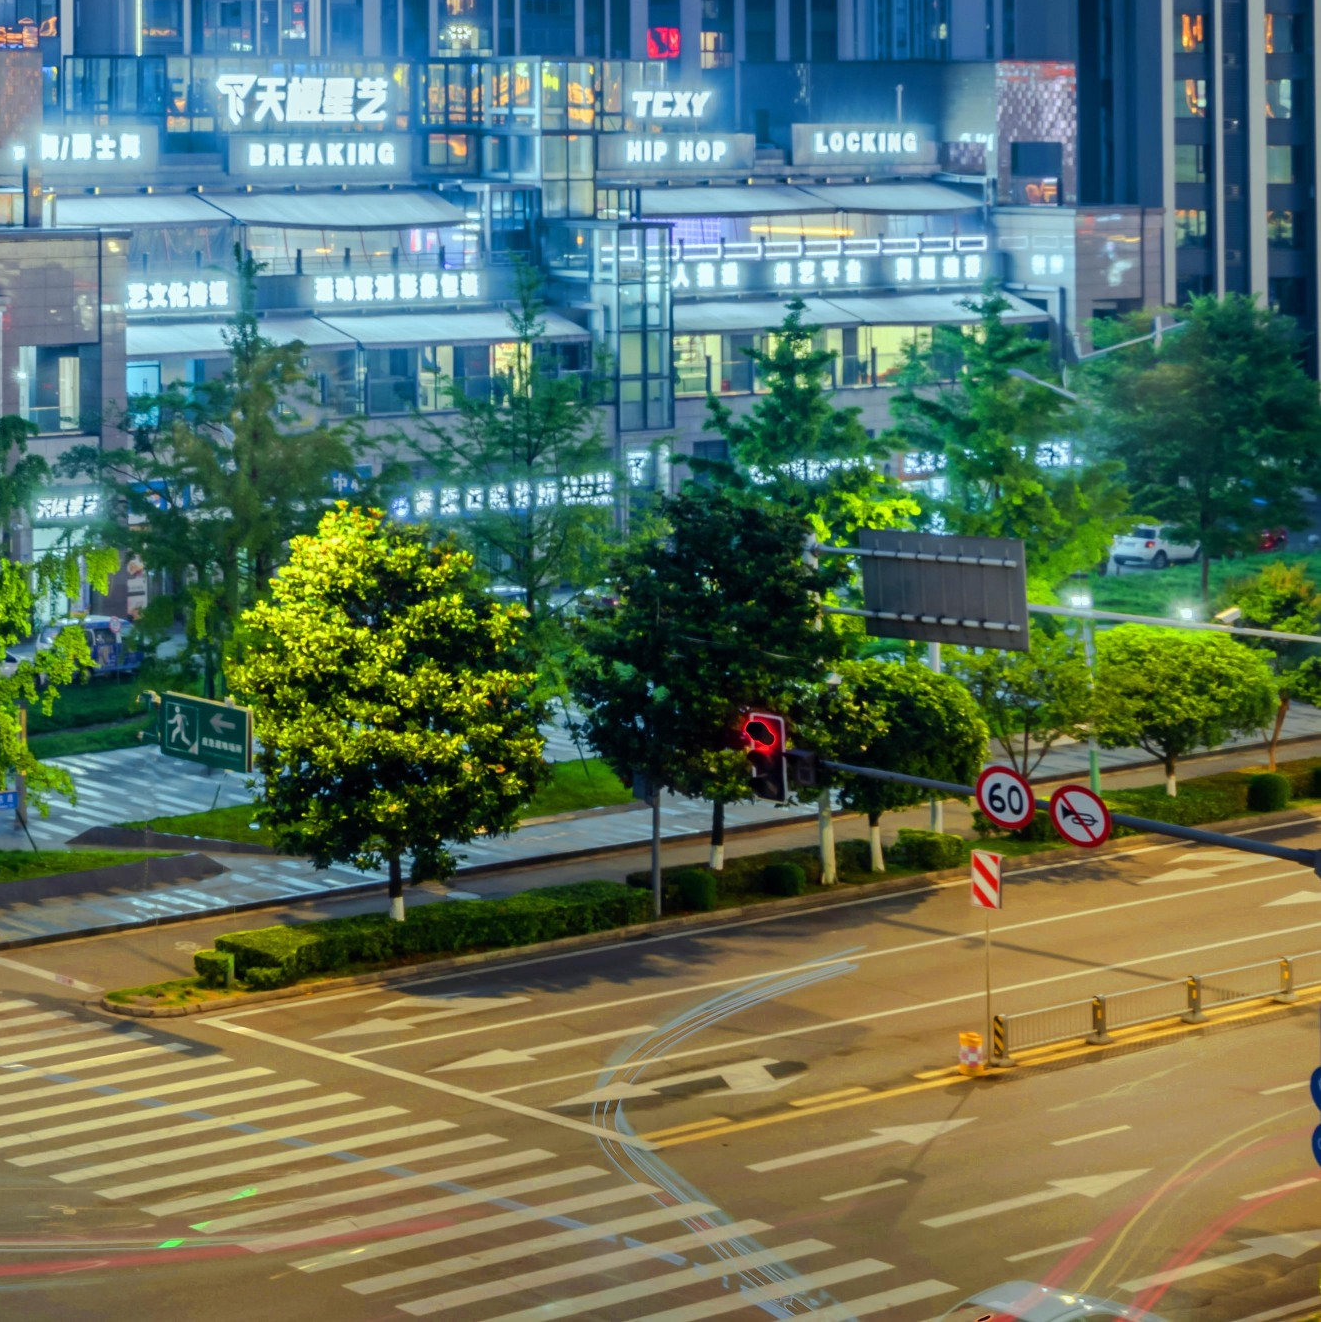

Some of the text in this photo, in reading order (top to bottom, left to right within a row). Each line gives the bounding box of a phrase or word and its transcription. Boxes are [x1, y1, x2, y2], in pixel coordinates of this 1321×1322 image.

[248, 142, 395, 167] BREAKING
[626, 140, 726, 163] HIP HOP
[815, 131, 918, 154] LOCKING
[988, 782, 1024, 816] 60
